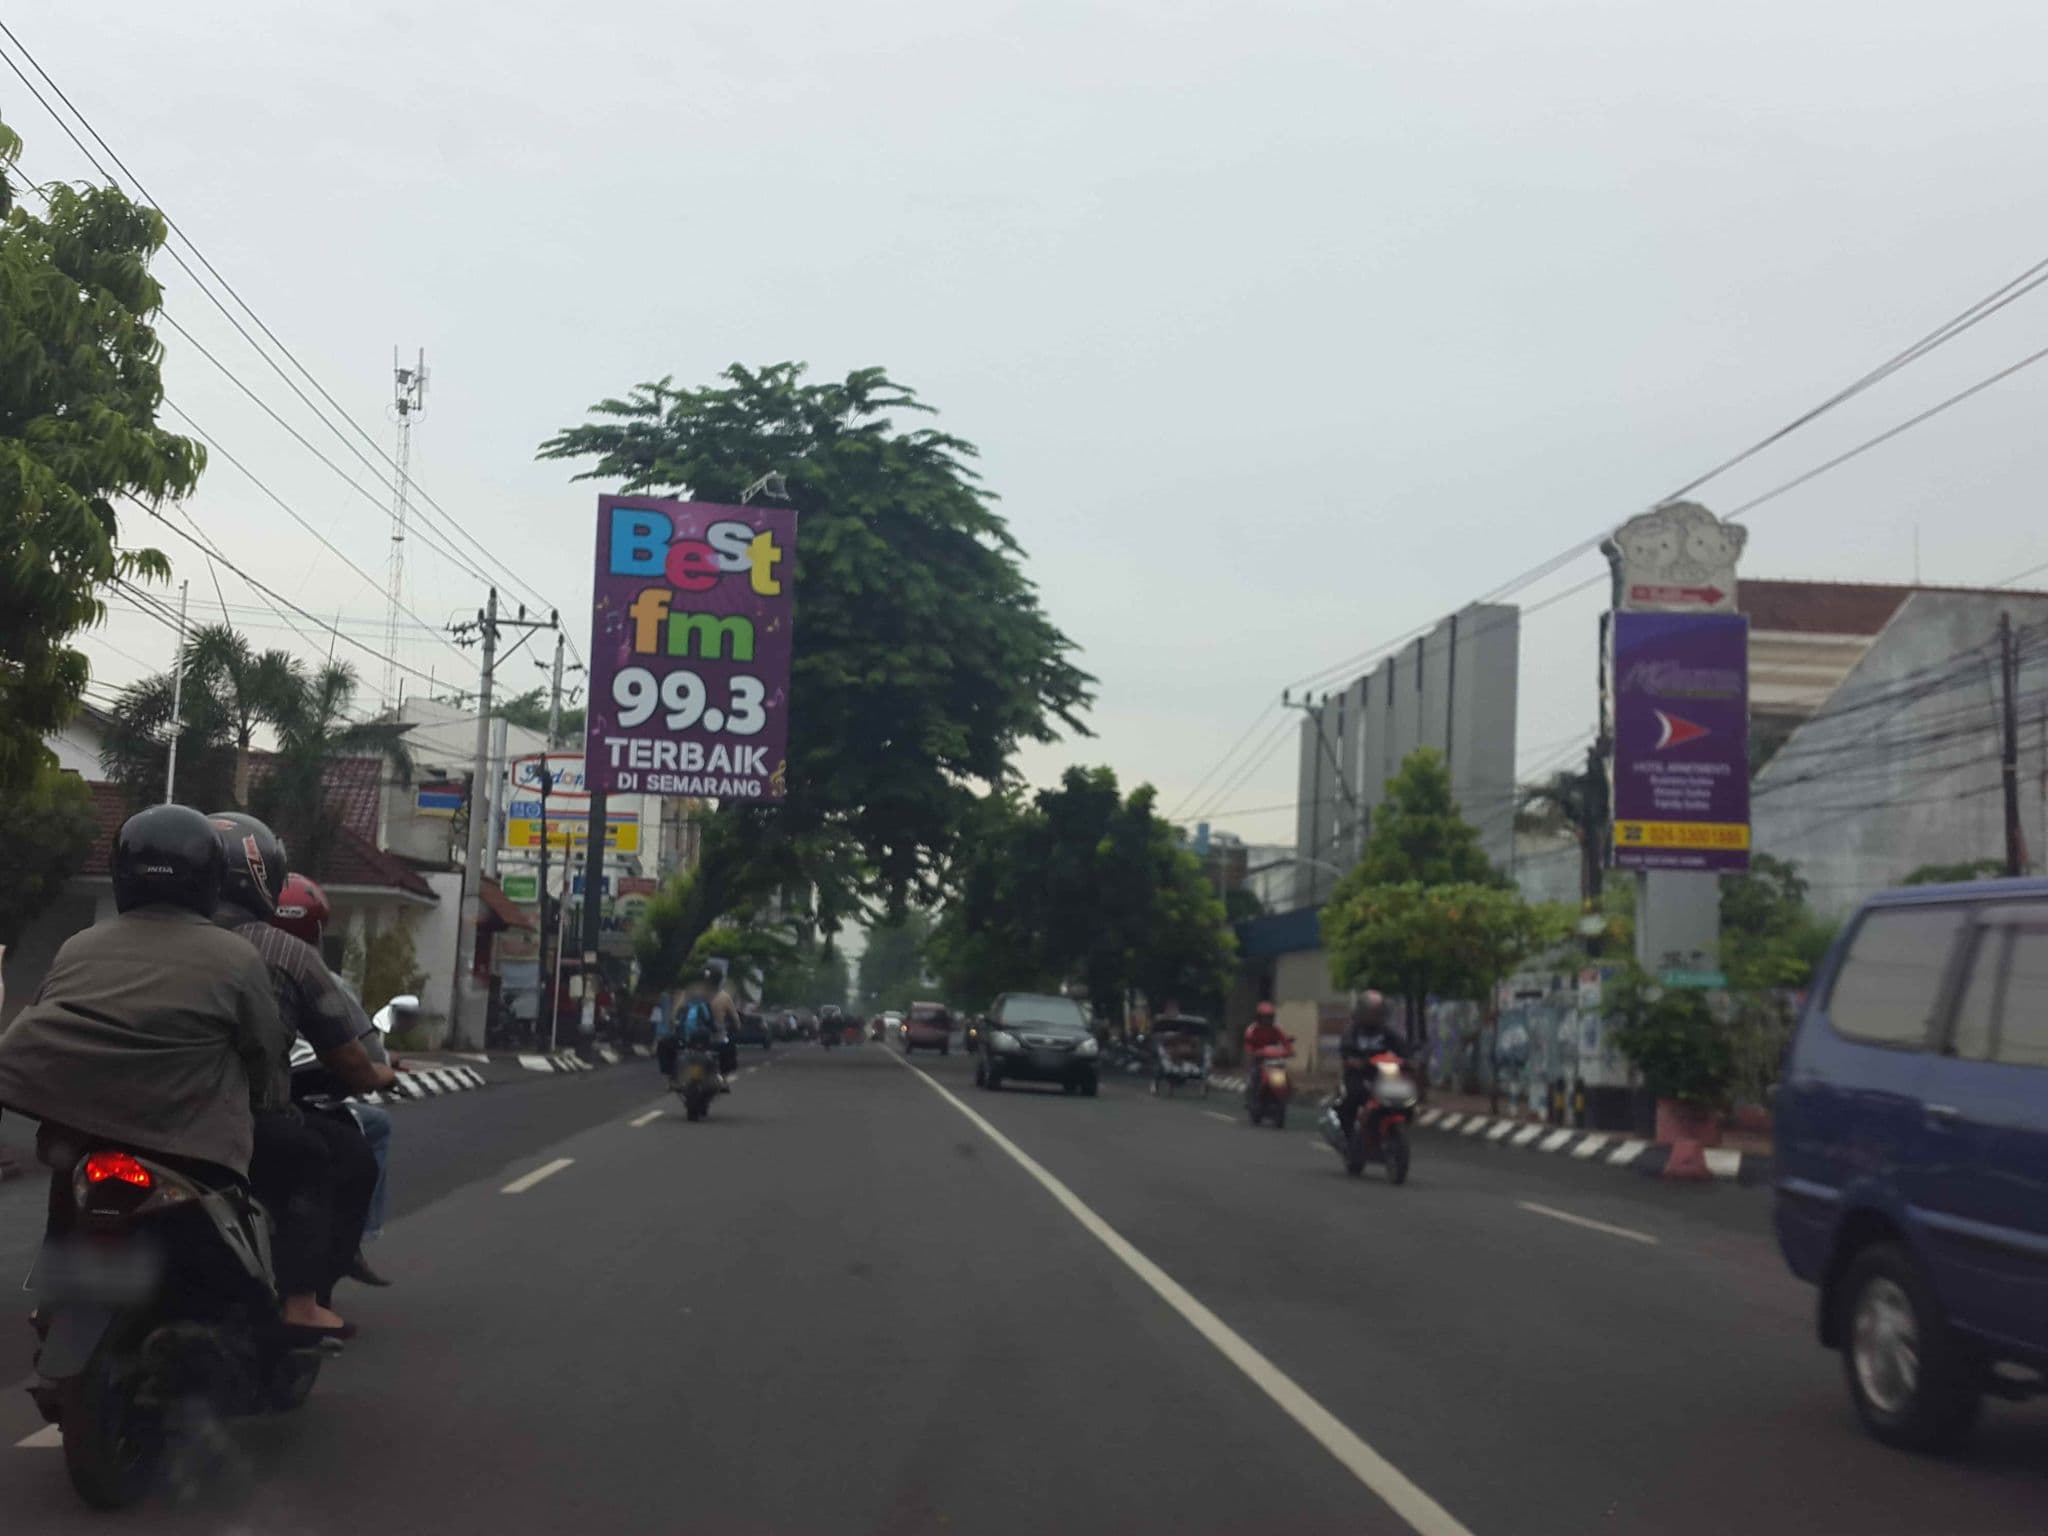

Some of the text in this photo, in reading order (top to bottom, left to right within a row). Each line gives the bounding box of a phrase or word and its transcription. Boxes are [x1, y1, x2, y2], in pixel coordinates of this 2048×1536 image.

[610, 507, 782, 596] Best
[630, 588, 754, 661] fm
[612, 667, 766, 735] 99.3
[604, 737, 769, 776] TERBAIK
[617, 772, 762, 797] DI SEMARANG
